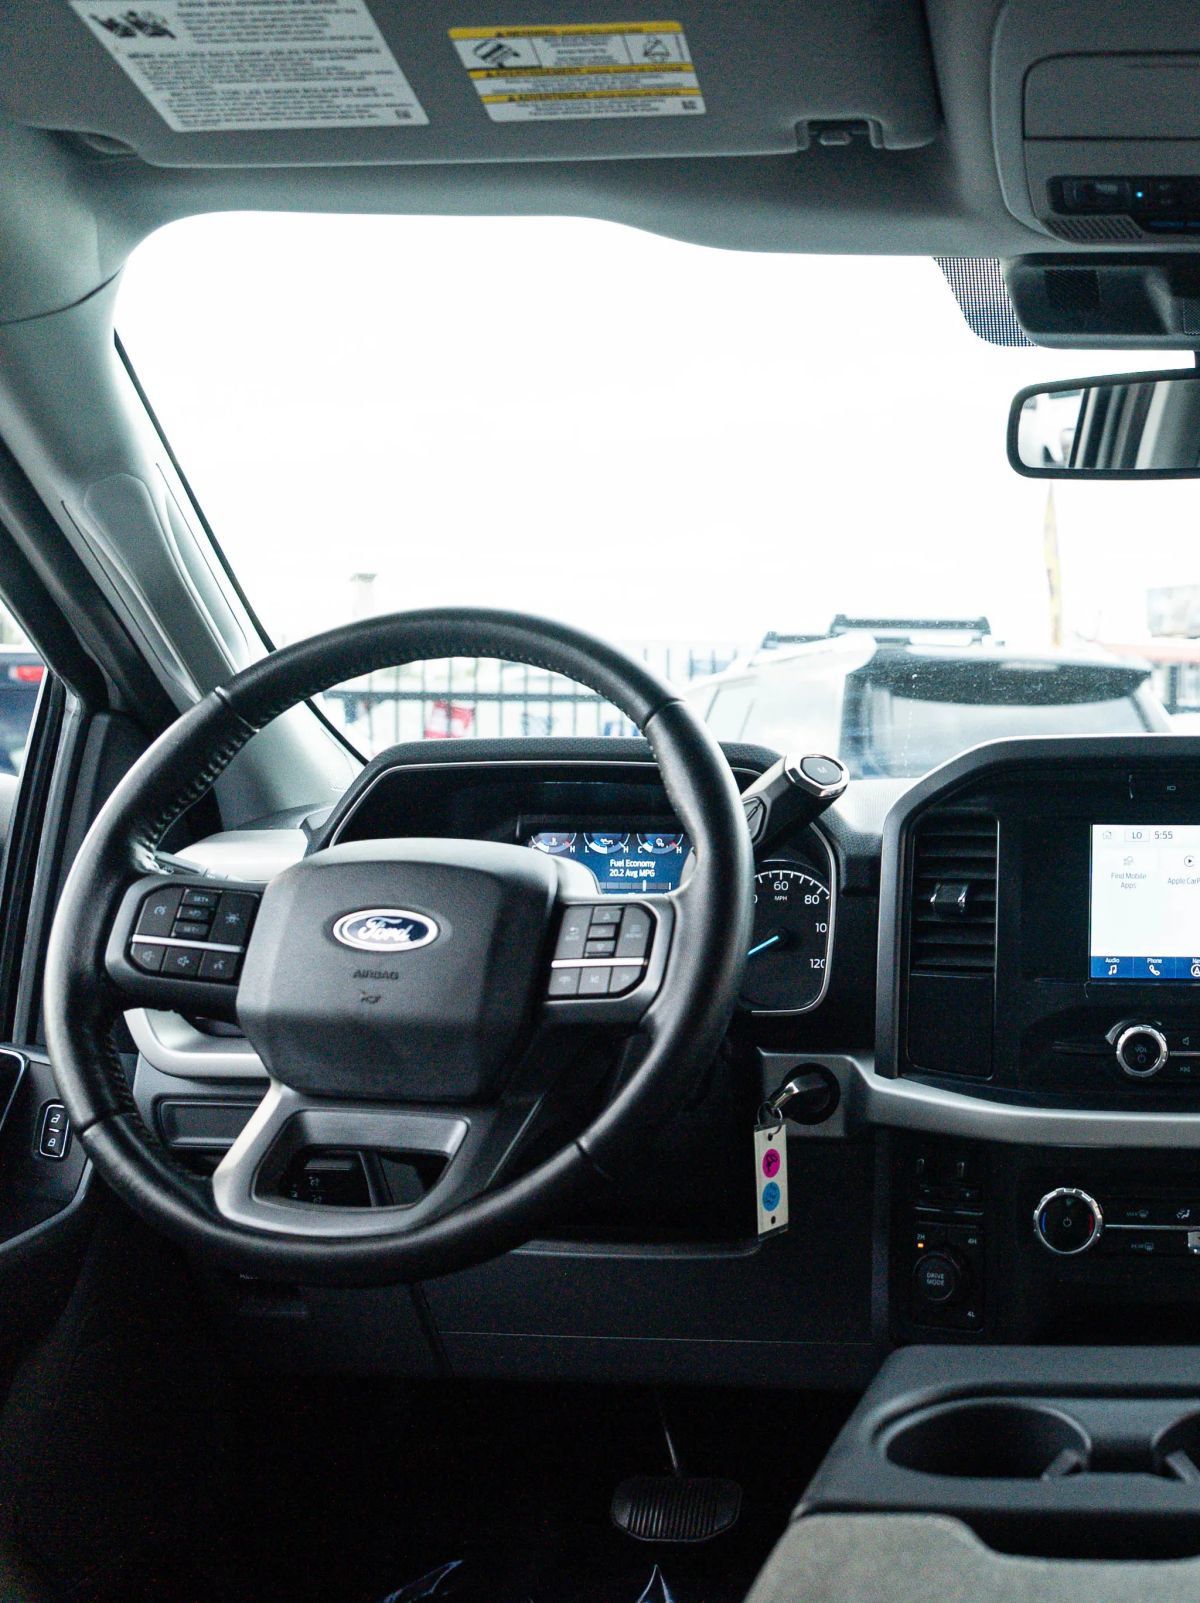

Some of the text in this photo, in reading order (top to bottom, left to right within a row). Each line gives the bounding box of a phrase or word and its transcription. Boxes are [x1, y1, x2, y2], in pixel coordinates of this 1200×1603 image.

[1132, 831, 1142, 840] LO
[1154, 830, 1174, 840] 5:55
[610, 859, 656, 870] Fuel Economy
[625, 870, 638, 878] Avg
[1125, 872, 1147, 880] Mobile
[773, 880, 789, 891] 60
[1120, 882, 1137, 890] Apps
[1167, 877, 1185, 886] Apple
[804, 894, 820, 905] 80
[358, 916, 415, 942] Ford
[352, 969, 400, 980] AIRBAG
